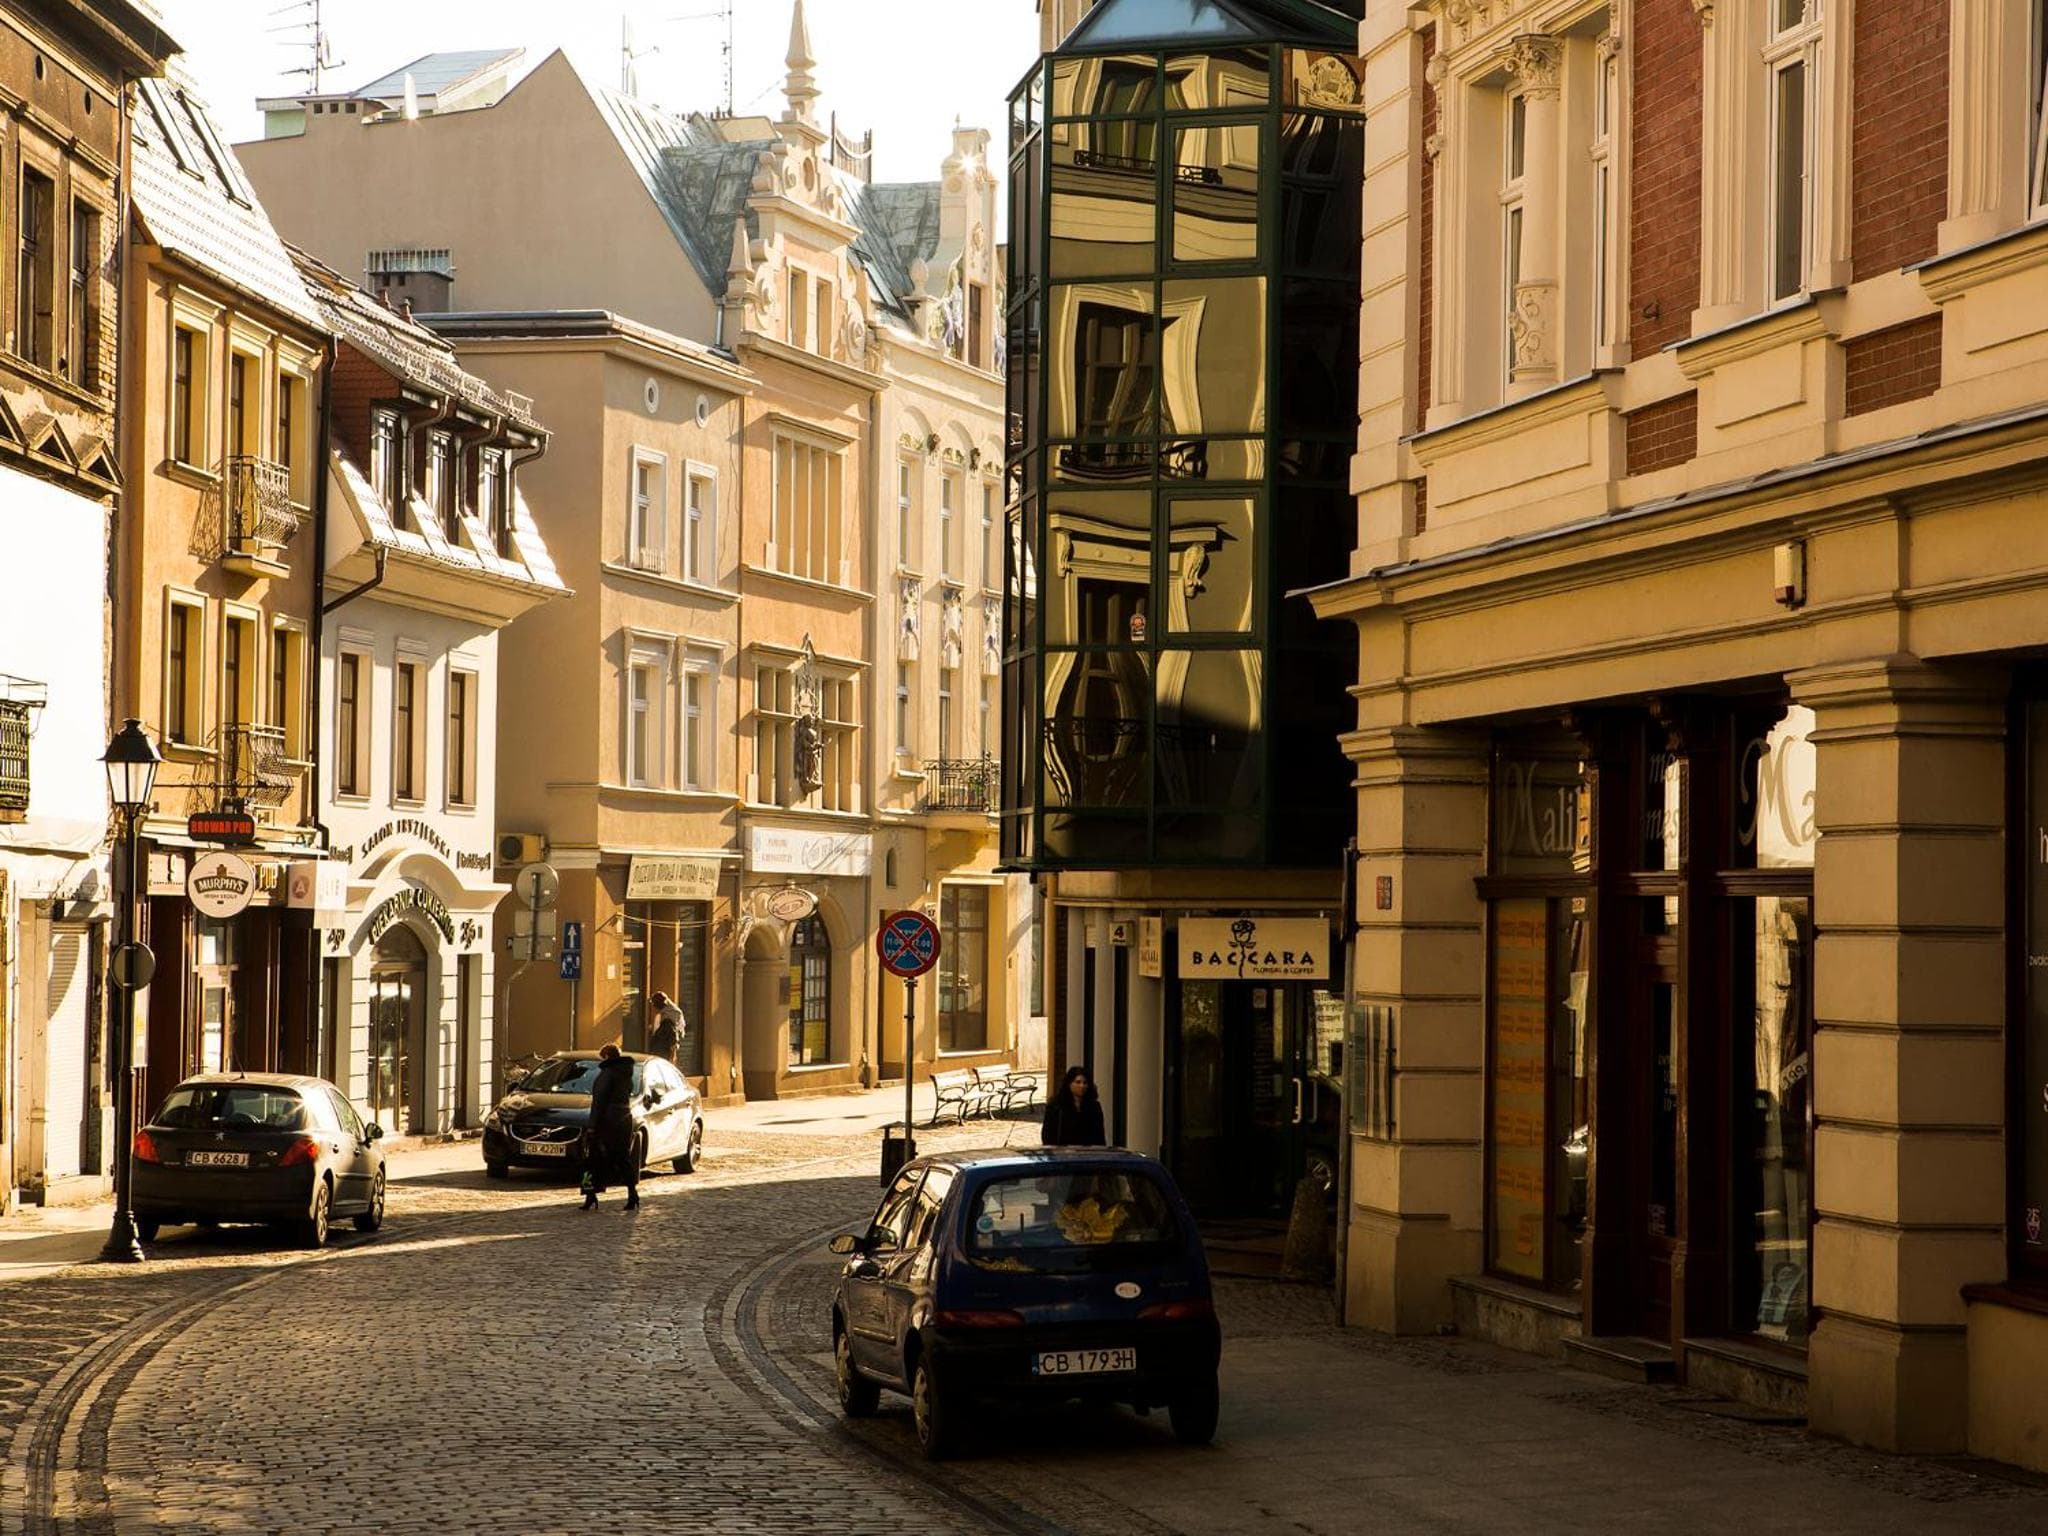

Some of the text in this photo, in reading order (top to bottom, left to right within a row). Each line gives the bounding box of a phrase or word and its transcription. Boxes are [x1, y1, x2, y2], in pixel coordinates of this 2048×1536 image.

[1113, 925, 1125, 939] 4
[1191, 950, 1315, 965] BACCARA
[194, 1152, 246, 1165] CB 6628J
[1041, 1349, 1134, 1373] CB 1793H
